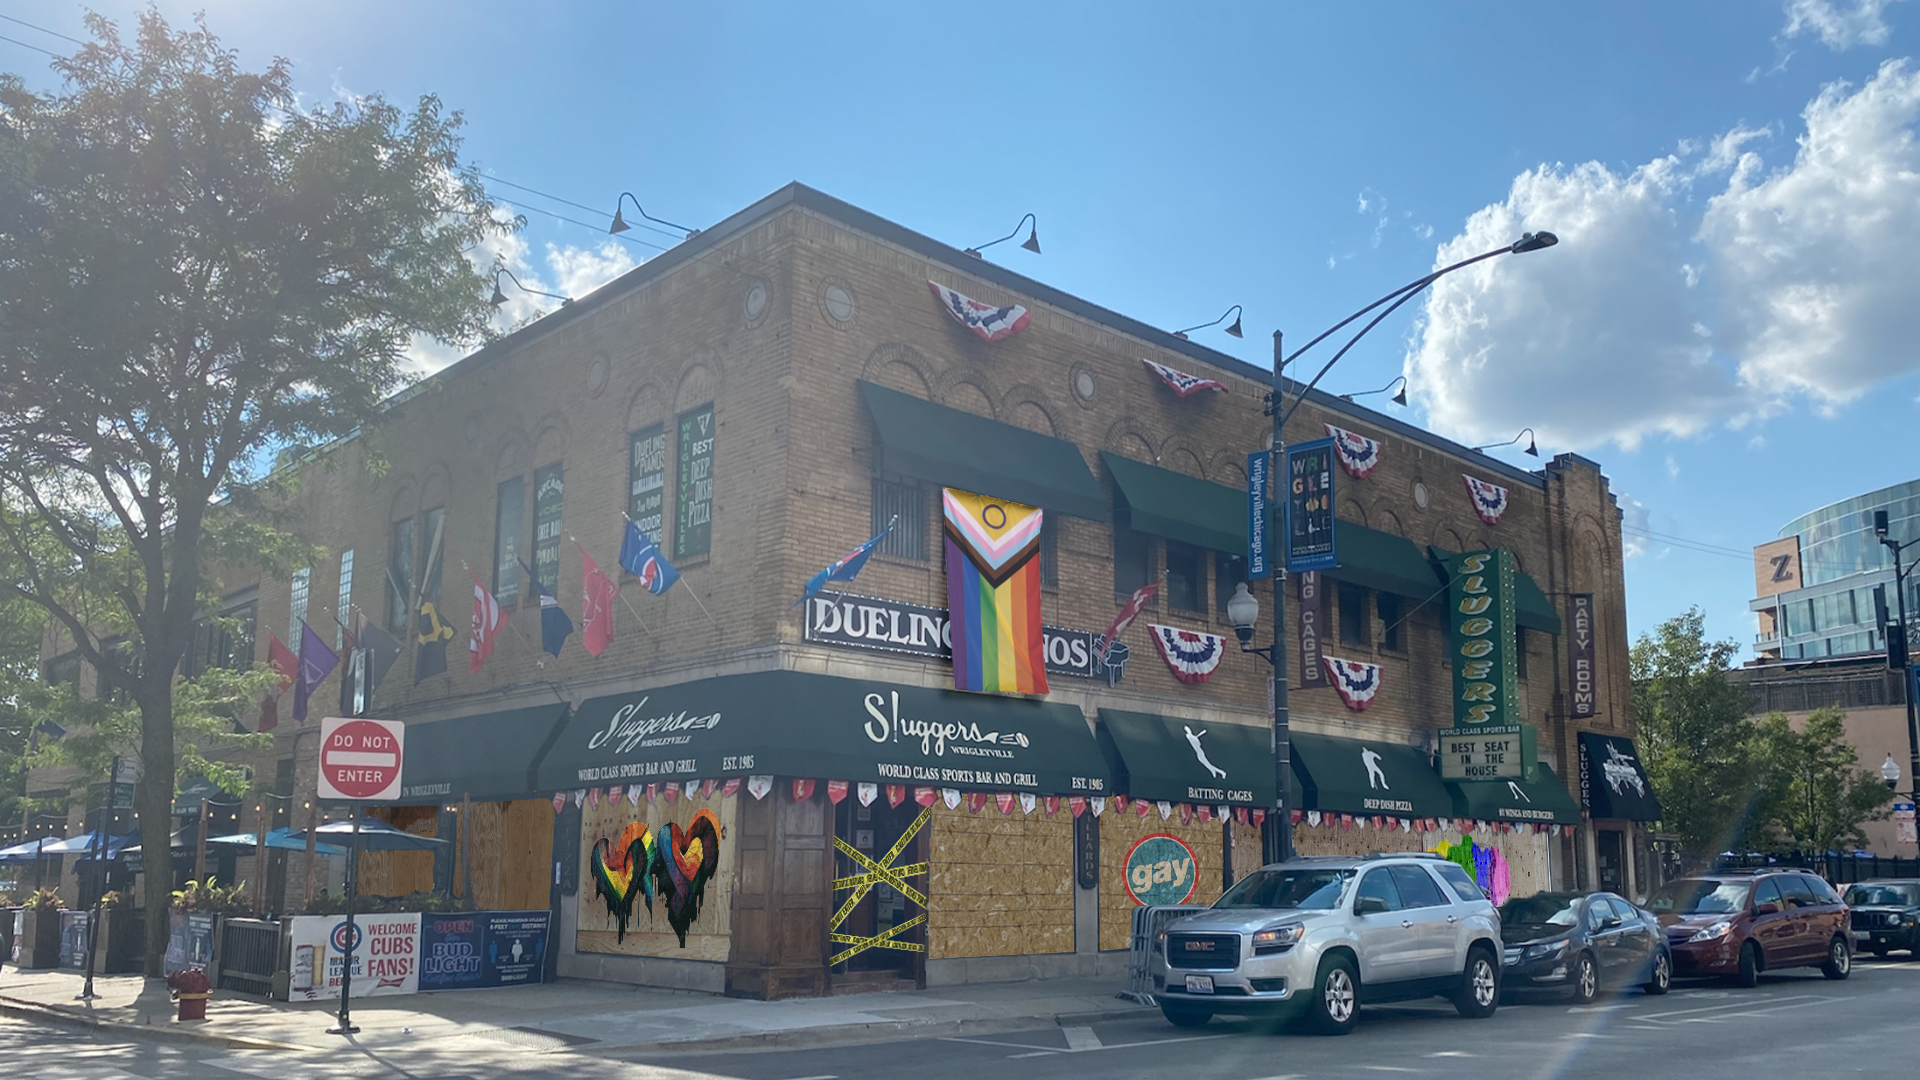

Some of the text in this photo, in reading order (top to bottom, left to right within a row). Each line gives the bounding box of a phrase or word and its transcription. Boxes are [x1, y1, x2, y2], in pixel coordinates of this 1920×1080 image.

[635, 434, 665, 468] DUELING
[692, 438, 714, 457] BEST
[640, 450, 664, 477] PIANOS
[691, 457, 710, 484] DEEP
[538, 478, 564, 501] ARCADE
[679, 422, 692, 554] WRIGLEYVILLES
[695, 478, 712, 504] DISH
[688, 502, 710, 528] PIZZA
[1252, 458, 1264, 573] wrigleyvillechicago.org
[1770, 554, 1793, 582] Z
[1302, 612, 1318, 680] CAGES
[1458, 554, 1496, 724] SLUGGERS
[1575, 598, 1592, 714] PARTY ROOMS
[588, 696, 694, 754] Sluggers
[864, 690, 999, 756] Sluggers
[1483, 726, 1506, 734] SPORTS
[334, 735, 390, 748] DO NOT
[640, 735, 692, 747] WRIGLEYVILLE
[1452, 742, 1510, 753] BEST SEAT
[951, 746, 1014, 758] WRIGLEYVILLE
[1461, 754, 1504, 764] IN THE
[338, 770, 382, 782] ENTER
[578, 755, 754, 781] WORLD CLASS SPORTS BAR AND GRILL EST. 1985
[878, 764, 1104, 790] WORLD CLASS SPORTS BAR AND GRILL EST. 1985
[1466, 766, 1498, 776] HOUSE
[403, 784, 450, 797] IN WRIGLEYVILLE
[1188, 787, 1253, 802] BATTING CAGES
[1364, 798, 1413, 812] DEEP DISH PIZZA
[564, 828, 572, 888] PIZZA
[1132, 858, 1190, 894] gay
[368, 923, 418, 936] WELCOME
[434, 920, 474, 933] OPEN
[371, 936, 414, 956] CUBS
[432, 942, 474, 958] BUD
[1185, 942, 1215, 951] GMC
[330, 966, 362, 976] LEAUE
[368, 958, 414, 978] FANS!
[424, 956, 480, 974] LIGHT
